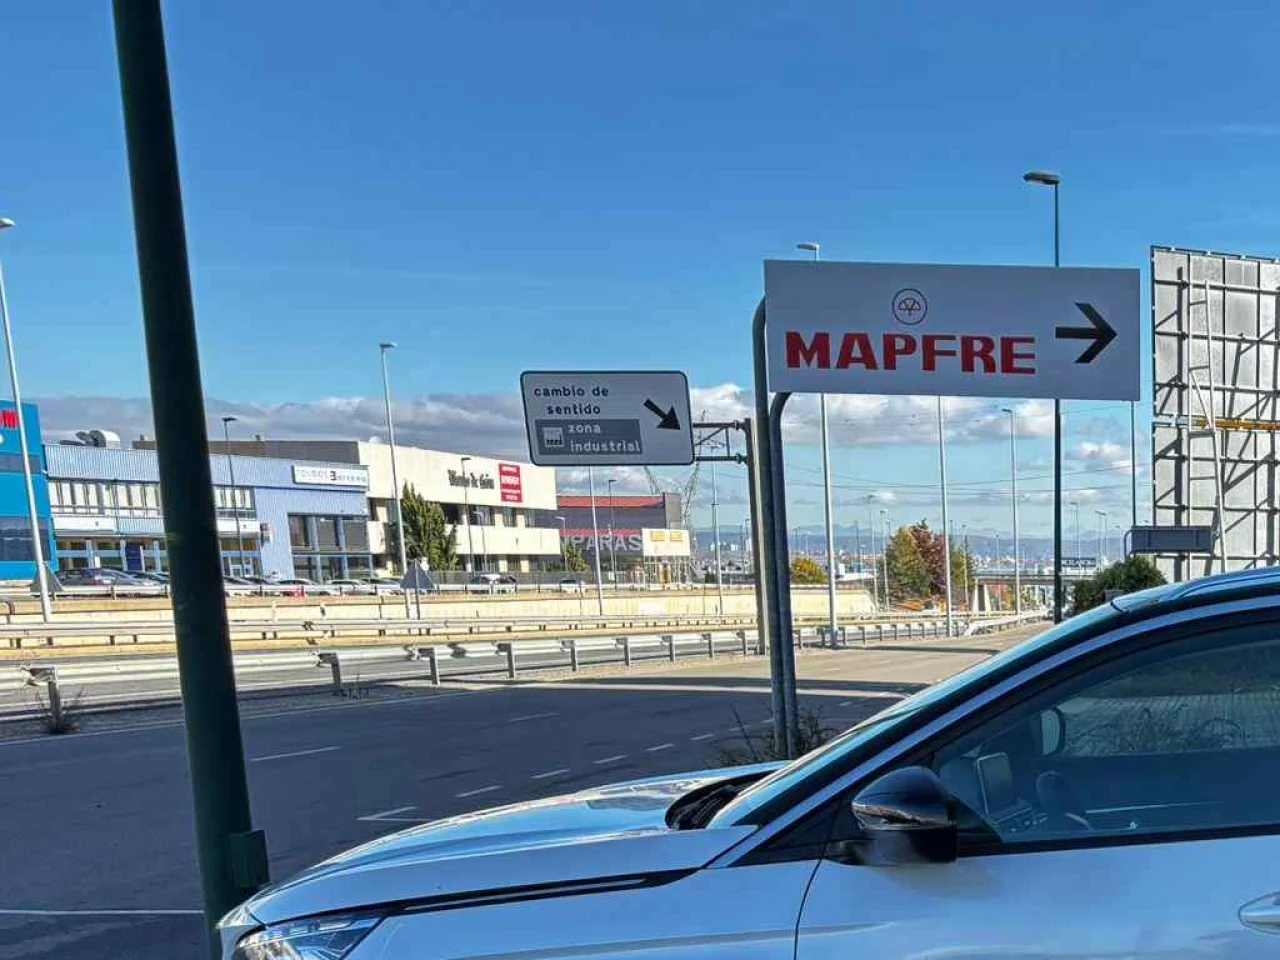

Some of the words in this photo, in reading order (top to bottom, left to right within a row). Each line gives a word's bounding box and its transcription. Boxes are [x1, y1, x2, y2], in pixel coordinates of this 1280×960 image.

[785, 331, 1036, 375] MAPFRE
[534, 385, 585, 397] cambio
[592, 385, 610, 397] de
[547, 403, 601, 415] sentido
[568, 423, 601, 434] zona
[570, 440, 640, 452] industrial
